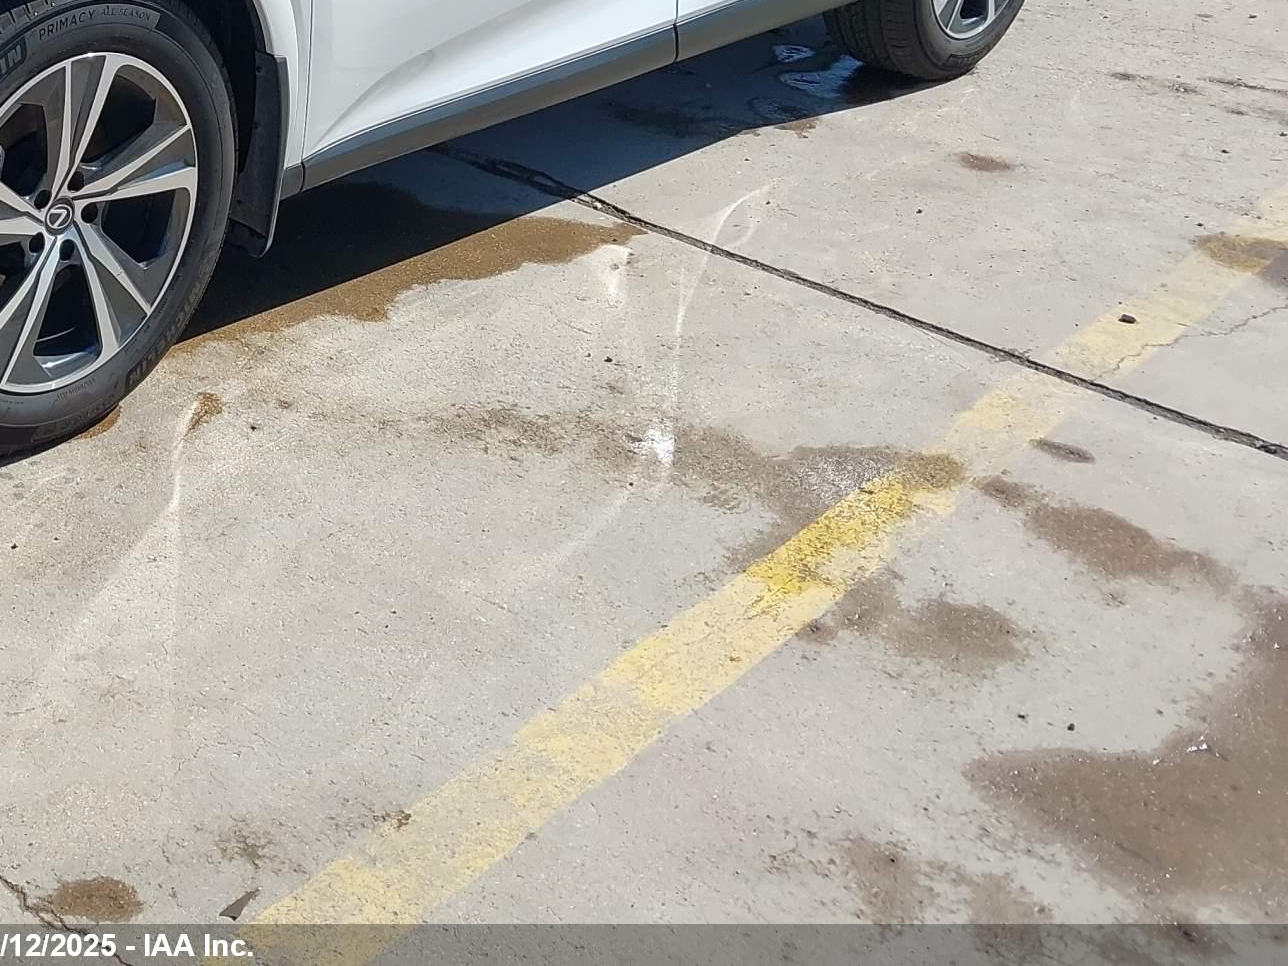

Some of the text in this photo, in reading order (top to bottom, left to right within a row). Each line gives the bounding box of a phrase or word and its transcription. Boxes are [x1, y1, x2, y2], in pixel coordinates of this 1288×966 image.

[38, 5, 151, 41] PRIMACY ALL SEASON
